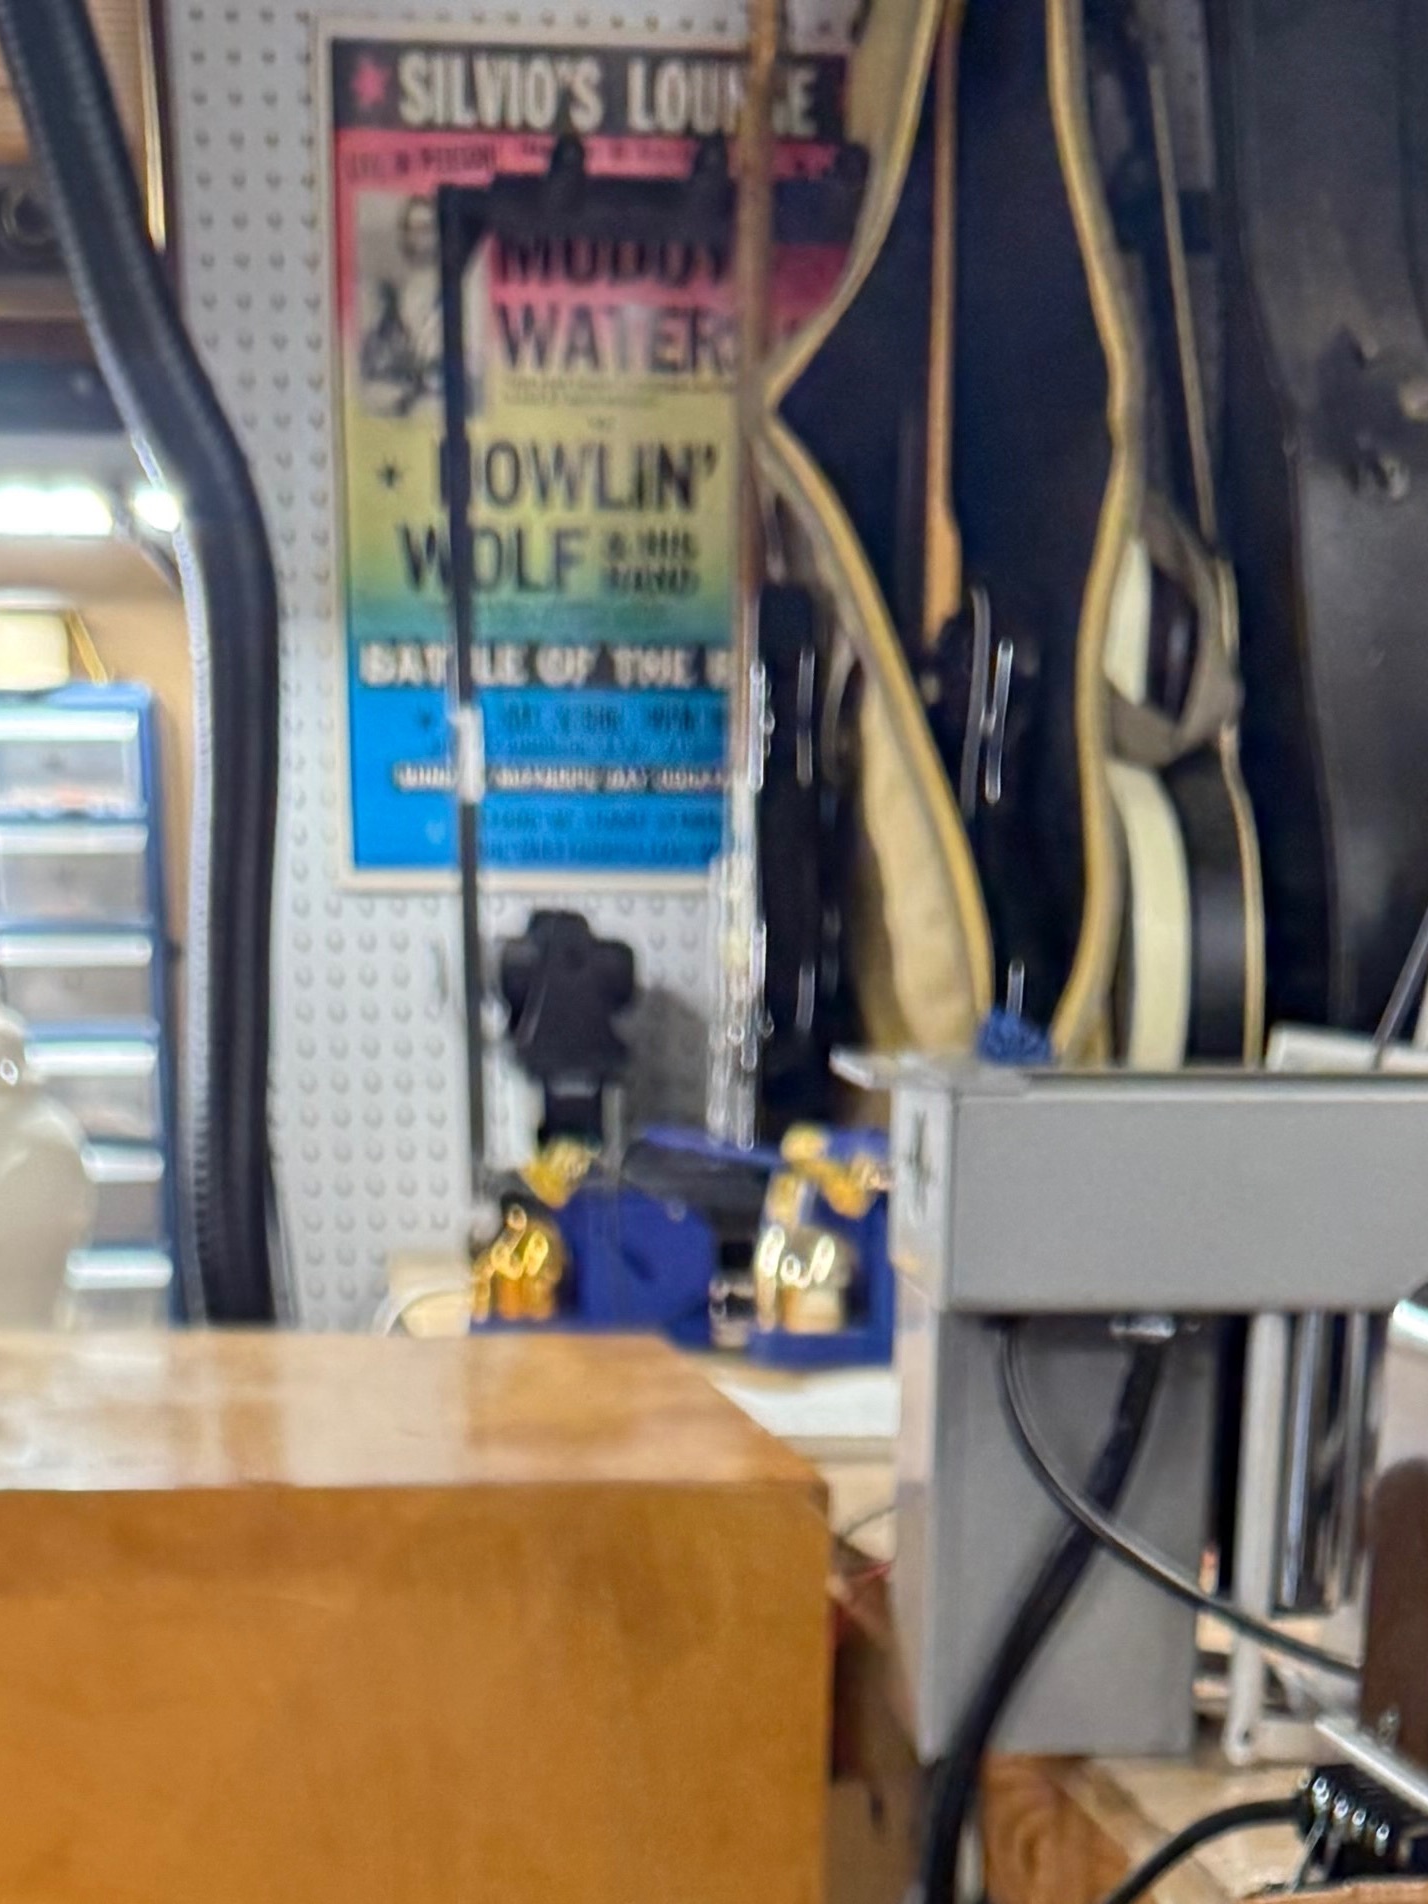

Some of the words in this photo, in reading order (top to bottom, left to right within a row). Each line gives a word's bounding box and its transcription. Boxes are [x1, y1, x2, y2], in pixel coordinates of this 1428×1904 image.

[398, 51, 603, 134] SILVIO'S
[627, 57, 818, 136] LOUNE
[494, 301, 740, 377] WATER
[400, 522, 588, 592] WOLF
[358, 641, 530, 688] BATLE
